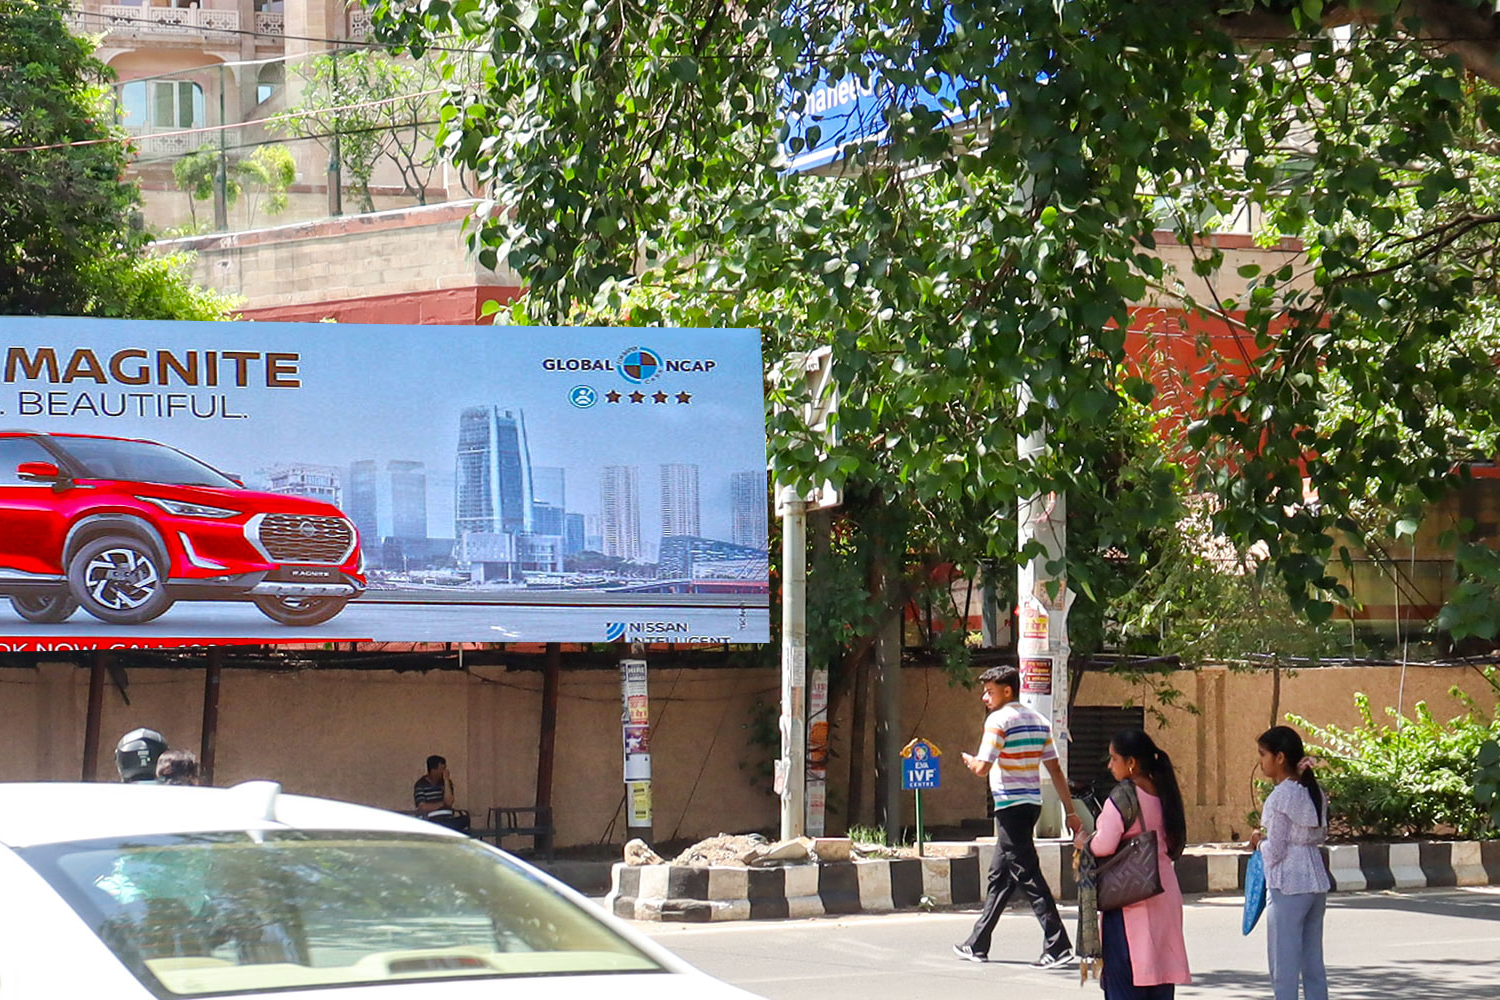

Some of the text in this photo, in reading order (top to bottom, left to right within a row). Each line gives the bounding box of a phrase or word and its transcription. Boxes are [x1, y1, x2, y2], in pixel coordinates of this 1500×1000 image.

[4, 347, 302, 388] MAGNITE
[542, 358, 716, 373] GLOBAL NCAP
[18, 390, 249, 419] BEAUTIFUL.
[629, 622, 688, 633] NISSAN
[909, 769, 935, 782] IVF
